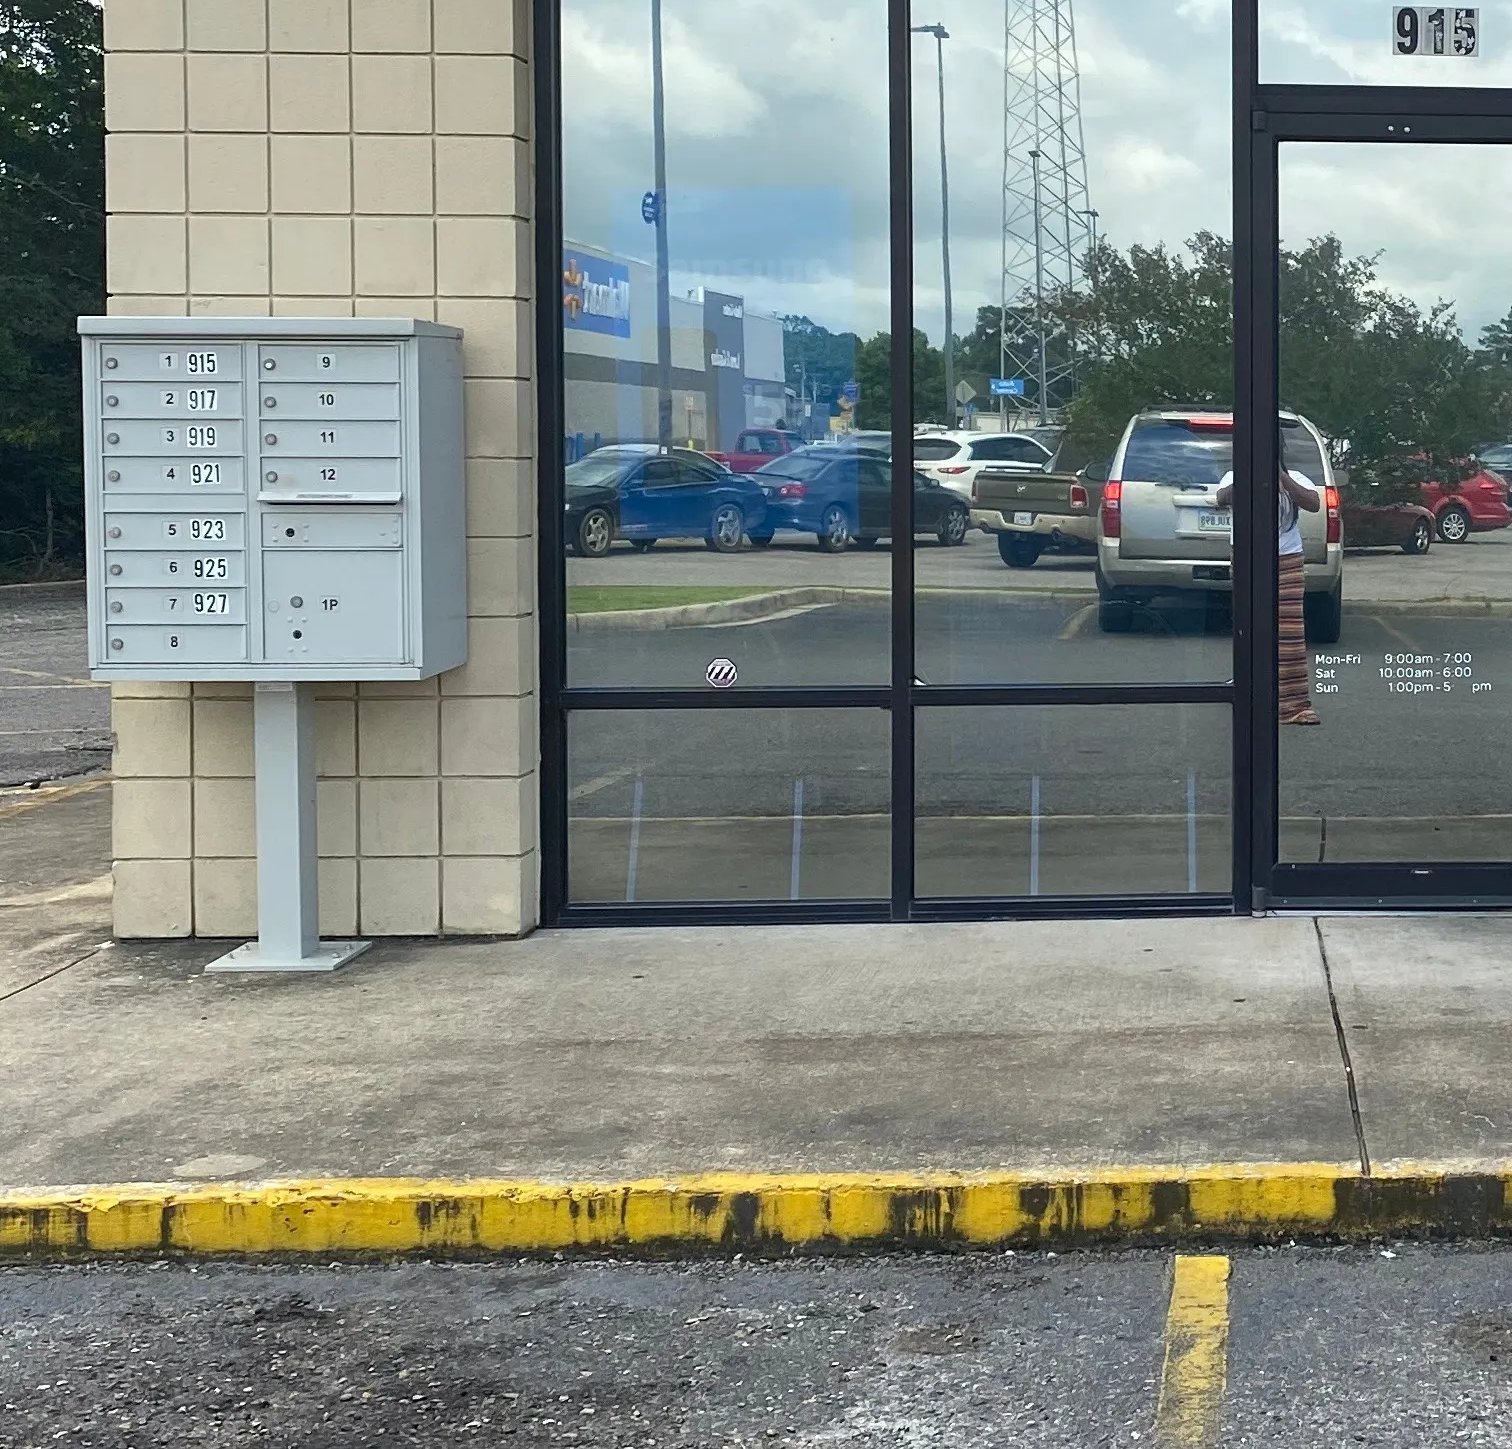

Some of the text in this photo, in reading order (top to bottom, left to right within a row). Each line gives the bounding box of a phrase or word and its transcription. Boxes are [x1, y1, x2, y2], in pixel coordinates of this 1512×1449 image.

[1396, 7, 1476, 56] 915
[165, 353, 216, 373] 1 915
[322, 356, 331, 369] 9
[165, 389, 216, 410] 2 917
[318, 393, 334, 406] 10
[166, 427, 216, 446] 3 919
[320, 431, 334, 443] 11
[166, 463, 220, 484] 4 921
[320, 468, 336, 481] 12
[168, 520, 224, 539] 5 923
[169, 558, 226, 578] 6 925
[169, 593, 227, 613] 7 927
[321, 598, 339, 611] 1P
[170, 635, 179, 648] 8
[1315, 653, 1361, 665] Mon-Fri
[1384, 653, 1434, 664] 9:00am
[1443, 652, 1472, 664] 7:00
[1315, 668, 1336, 679] Sat
[1378, 667, 1434, 678] 10:00am
[1442, 666, 1472, 678] 6:00
[1315, 682, 1339, 693] Sun
[1388, 681, 1434, 695] 1:00pm
[1472, 682, 1492, 694] pm
